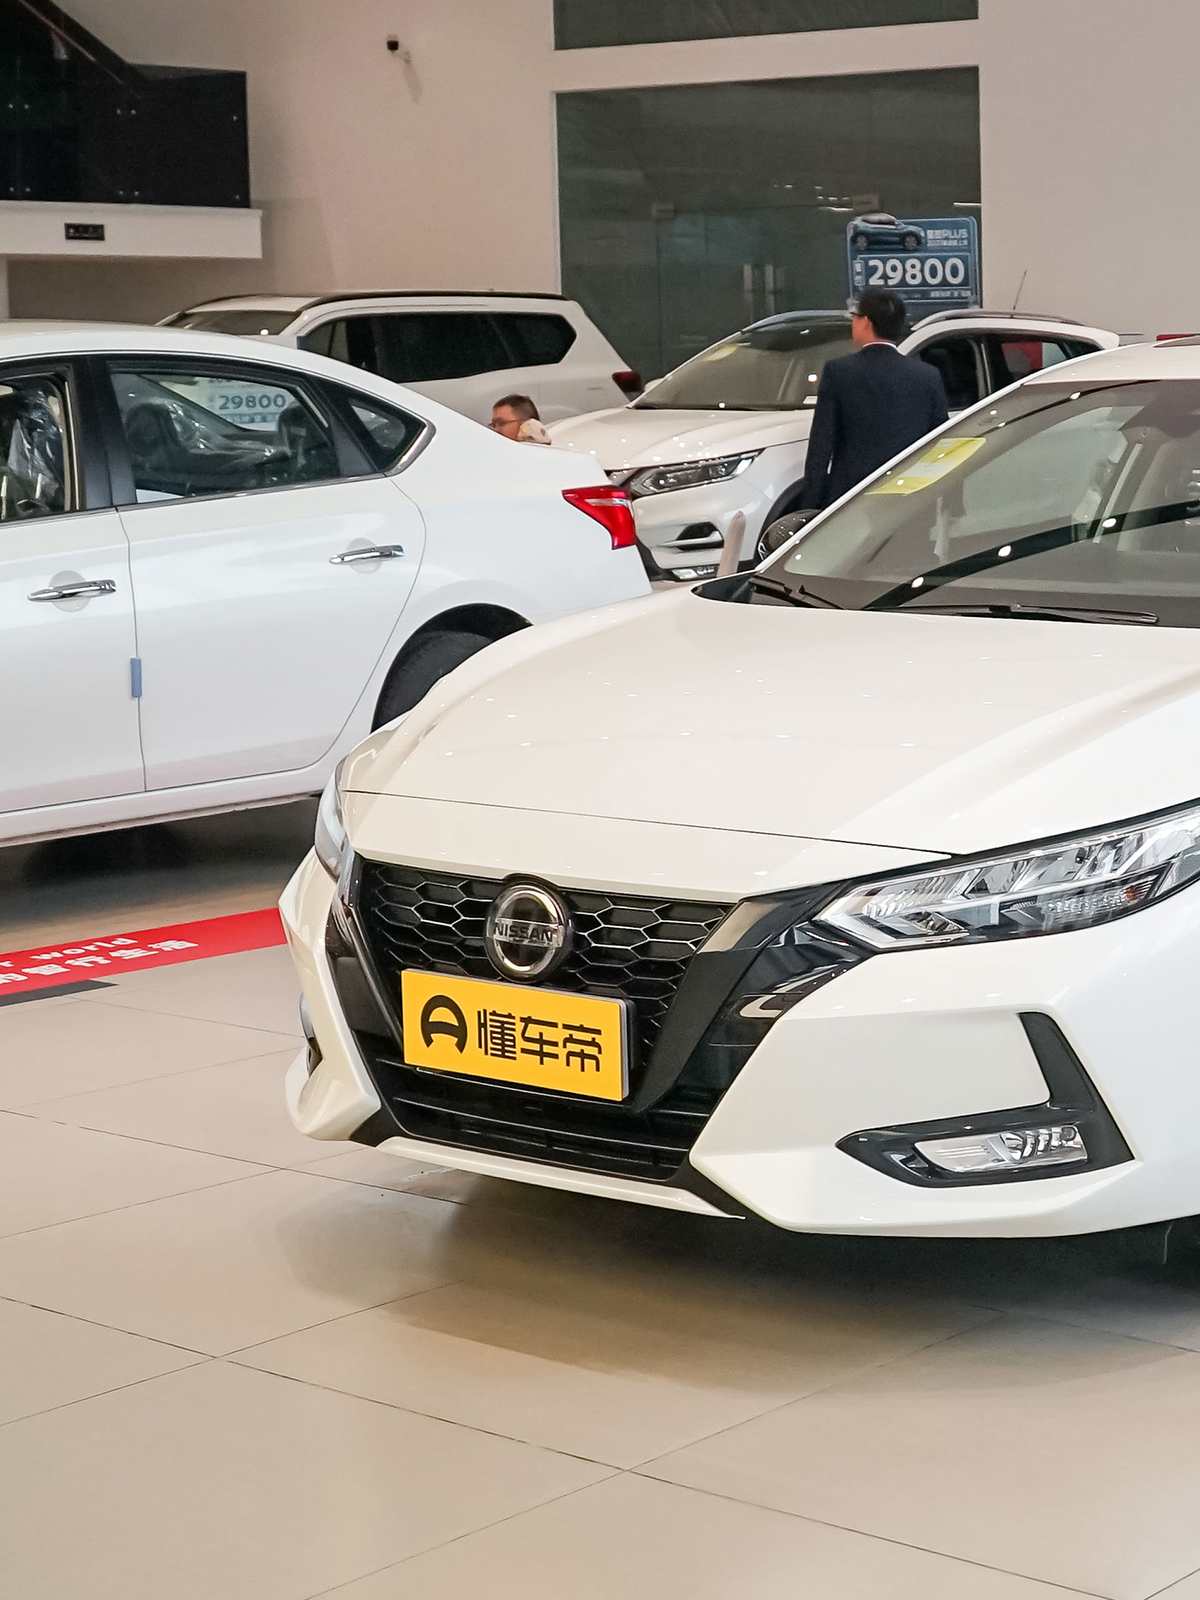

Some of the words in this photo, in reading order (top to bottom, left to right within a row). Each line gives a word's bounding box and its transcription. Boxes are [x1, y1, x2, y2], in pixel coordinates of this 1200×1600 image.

[868, 257, 965, 286] 29800
[218, 393, 287, 410] 29800
[493, 923, 557, 943] NISSAN
[30, 937, 139, 960] world
[476, 1008, 603, 1073] 懂车帝
